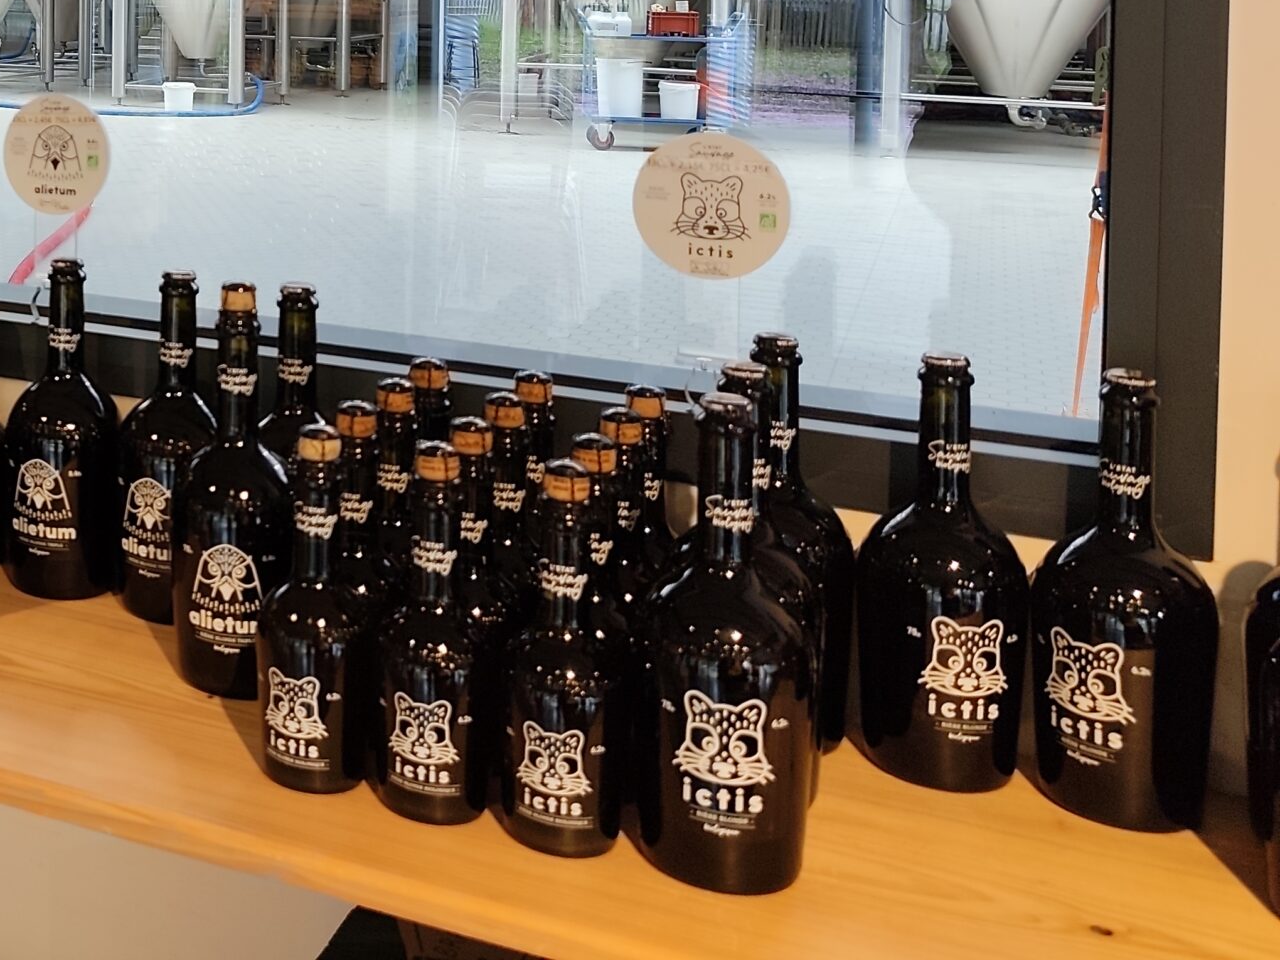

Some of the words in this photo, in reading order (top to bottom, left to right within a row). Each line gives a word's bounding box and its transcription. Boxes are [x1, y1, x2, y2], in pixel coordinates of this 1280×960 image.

[34, 184, 77, 196] alietum
[688, 242, 733, 258] ictis
[12, 516, 77, 540] alietum
[121, 536, 172, 561] alietu
[928, 693, 999, 720] ictis
[1051, 705, 1123, 749] ictis
[270, 729, 320, 758] ictis
[395, 756, 451, 784] ictis
[524, 787, 582, 816] ictis
[682, 776, 763, 813] ictis
